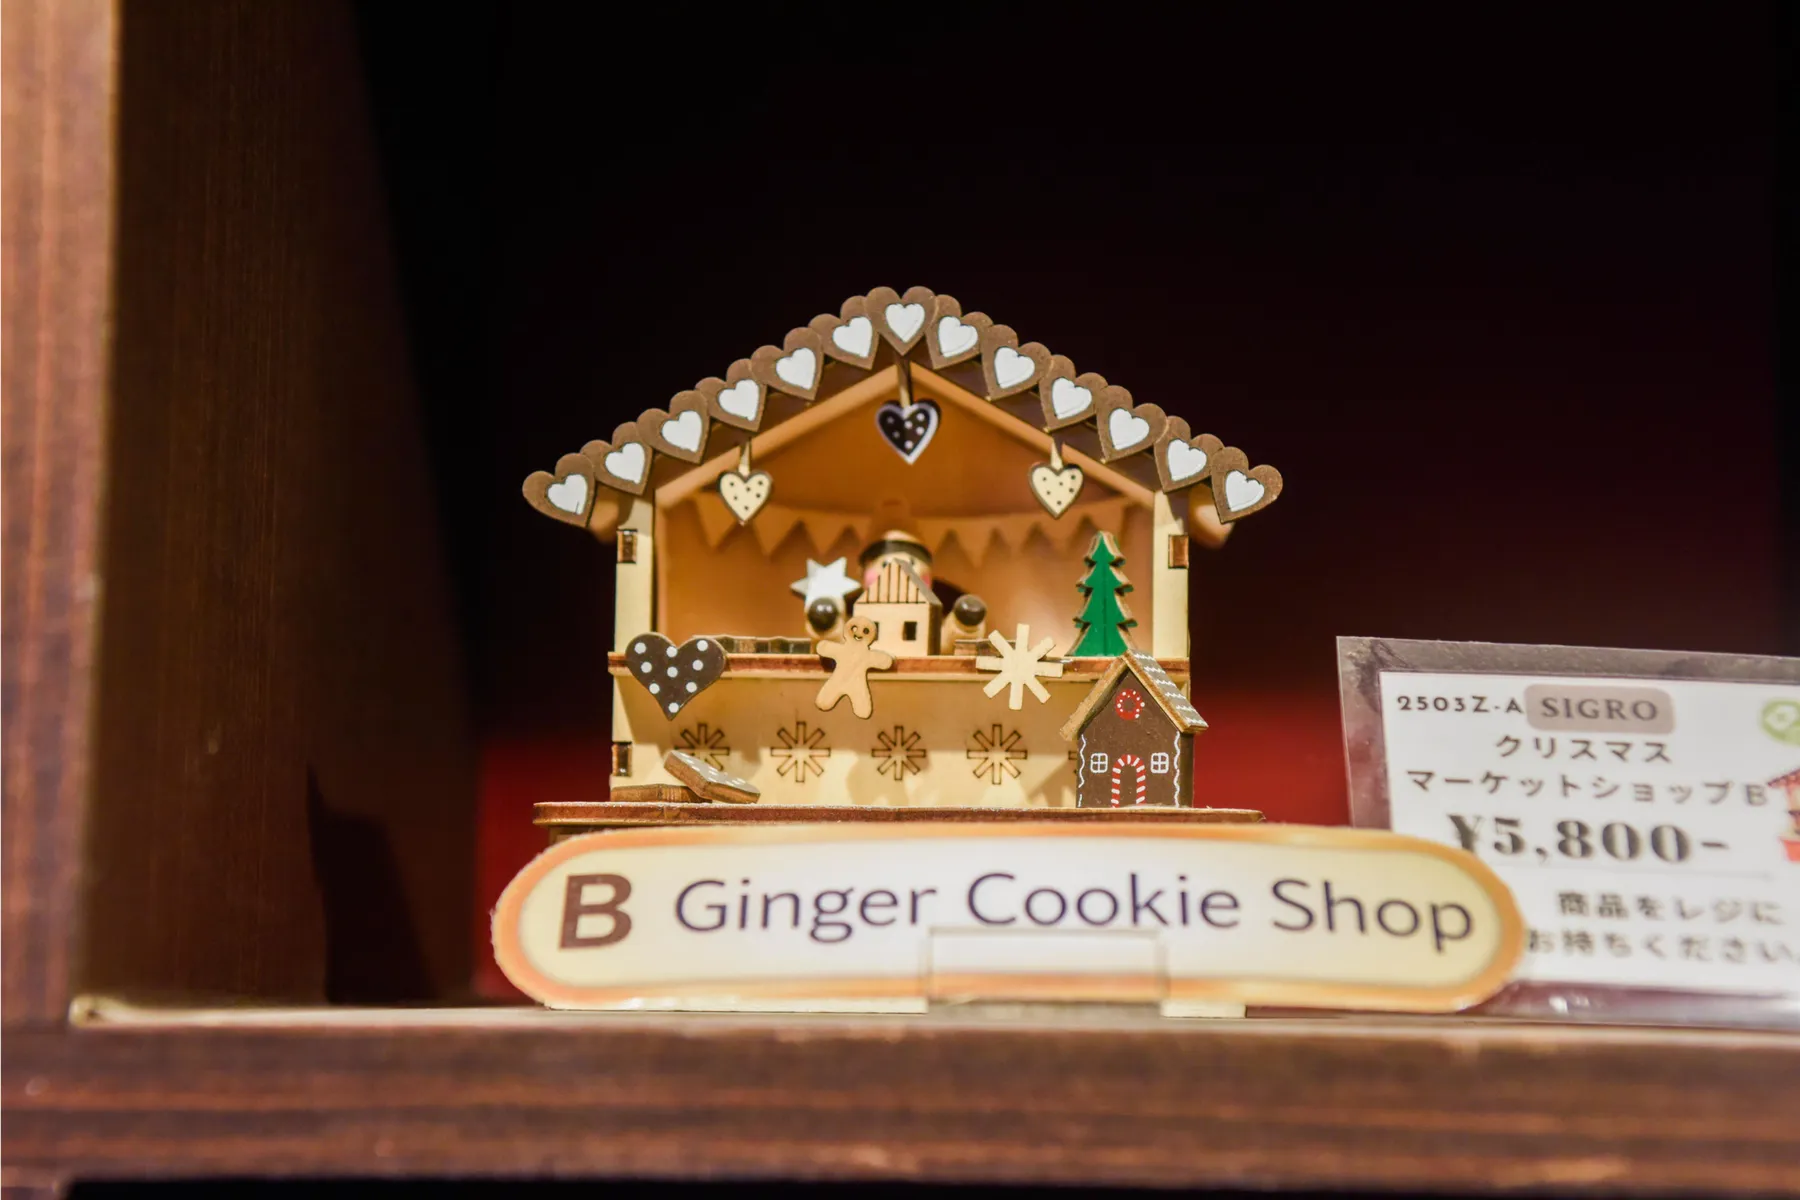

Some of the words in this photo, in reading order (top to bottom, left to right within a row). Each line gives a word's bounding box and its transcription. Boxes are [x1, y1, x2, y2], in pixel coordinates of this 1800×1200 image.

[1541, 698, 1659, 721] SIGRO
[1496, 735, 1672, 764] クリスマス
[560, 874, 632, 949] B
[675, 879, 937, 945] Ginger
[966, 872, 1240, 929] Cookie
[1270, 877, 1474, 953] Shop
[1558, 891, 1783, 924] 商品をレジに
